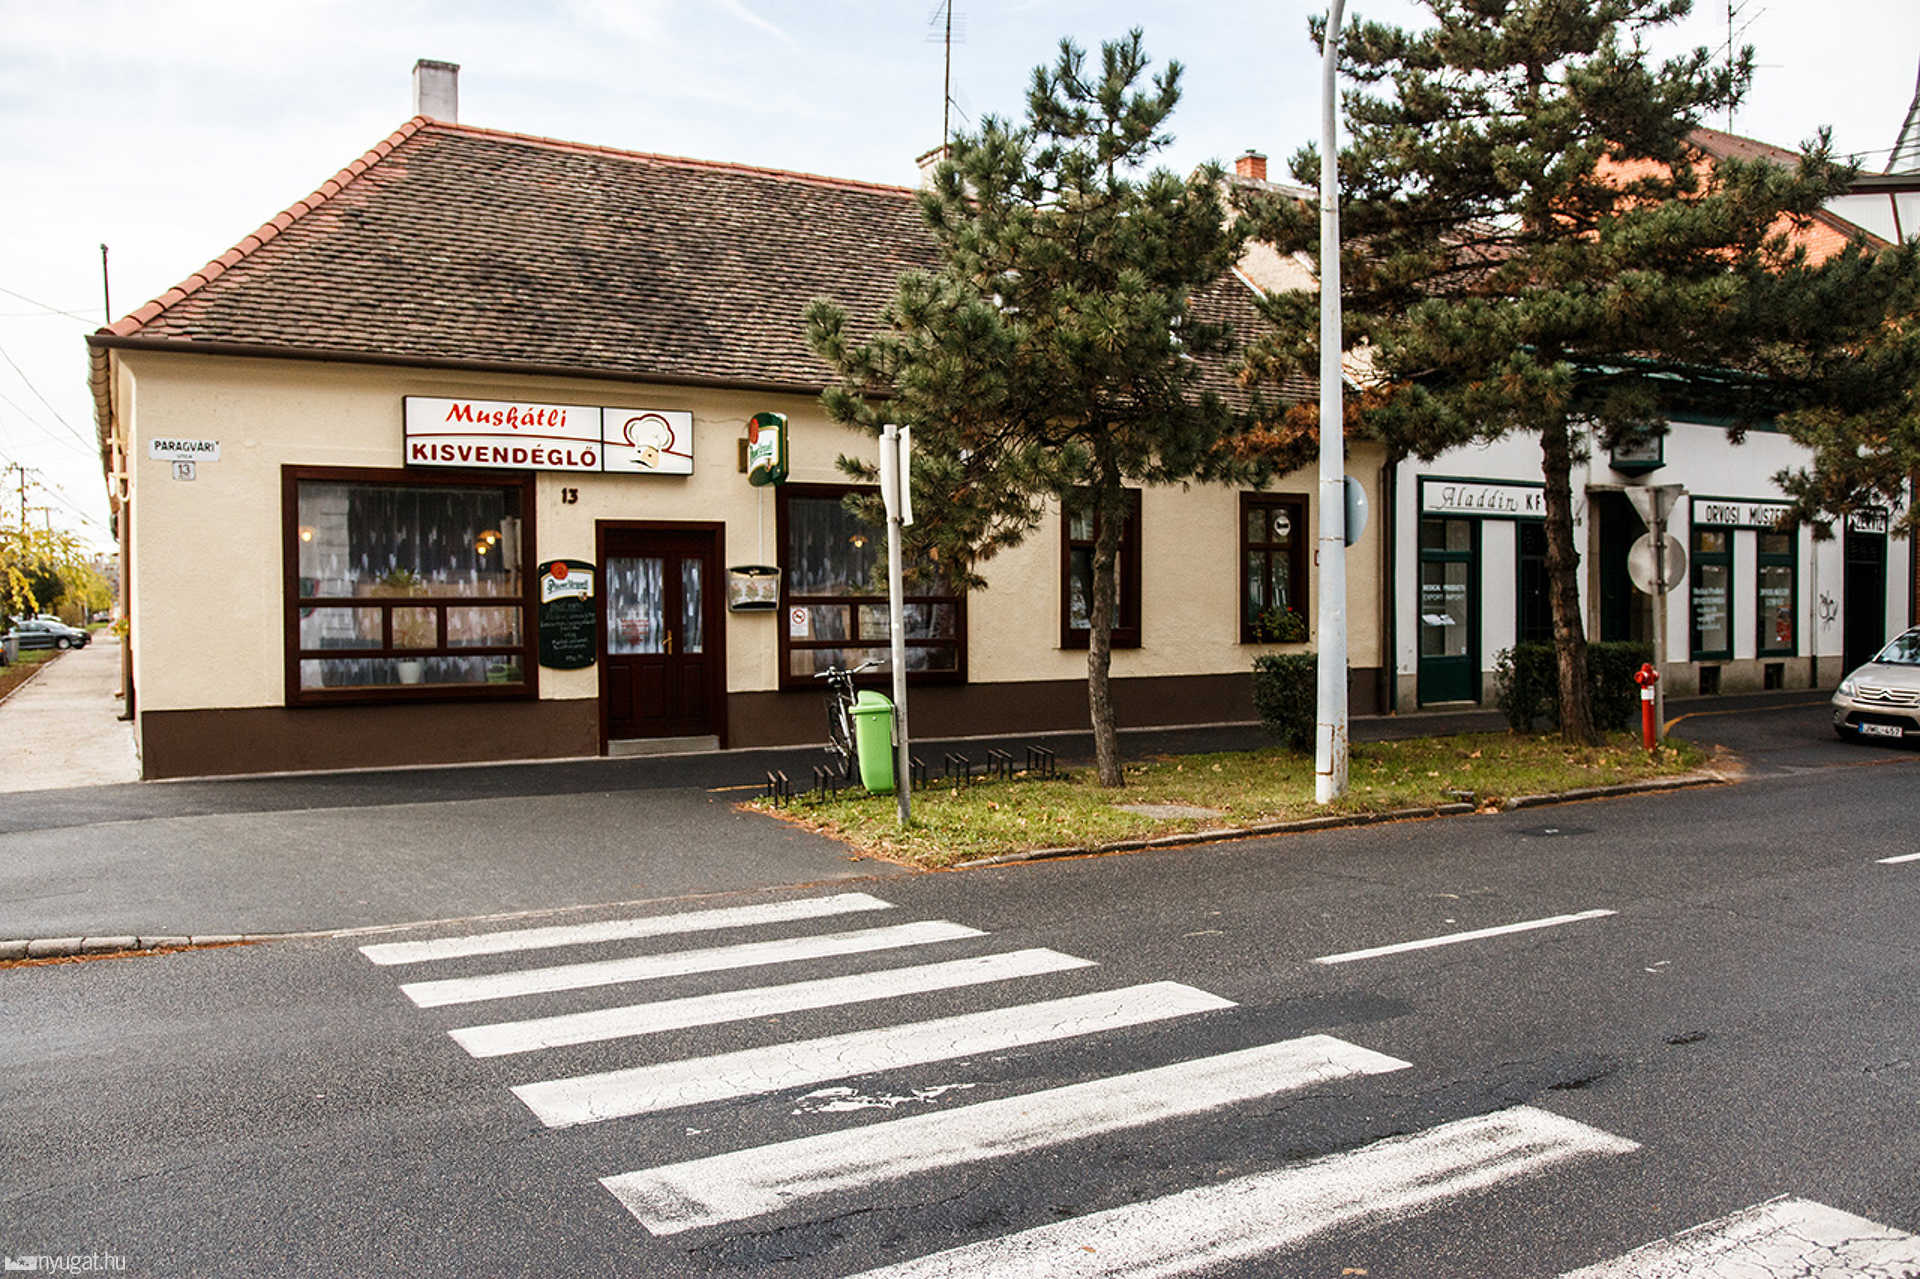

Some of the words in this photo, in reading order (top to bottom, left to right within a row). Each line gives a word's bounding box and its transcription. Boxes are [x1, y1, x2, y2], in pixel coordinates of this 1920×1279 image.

[445, 403, 568, 430] Muskátli
[412, 443, 596, 467] KISVENDÉGLŐ
[178, 463, 191, 476] 13
[561, 488, 578, 504] 13
[1525, 493, 1541, 511] KF
[1705, 504, 1739, 524] ORVOSI
